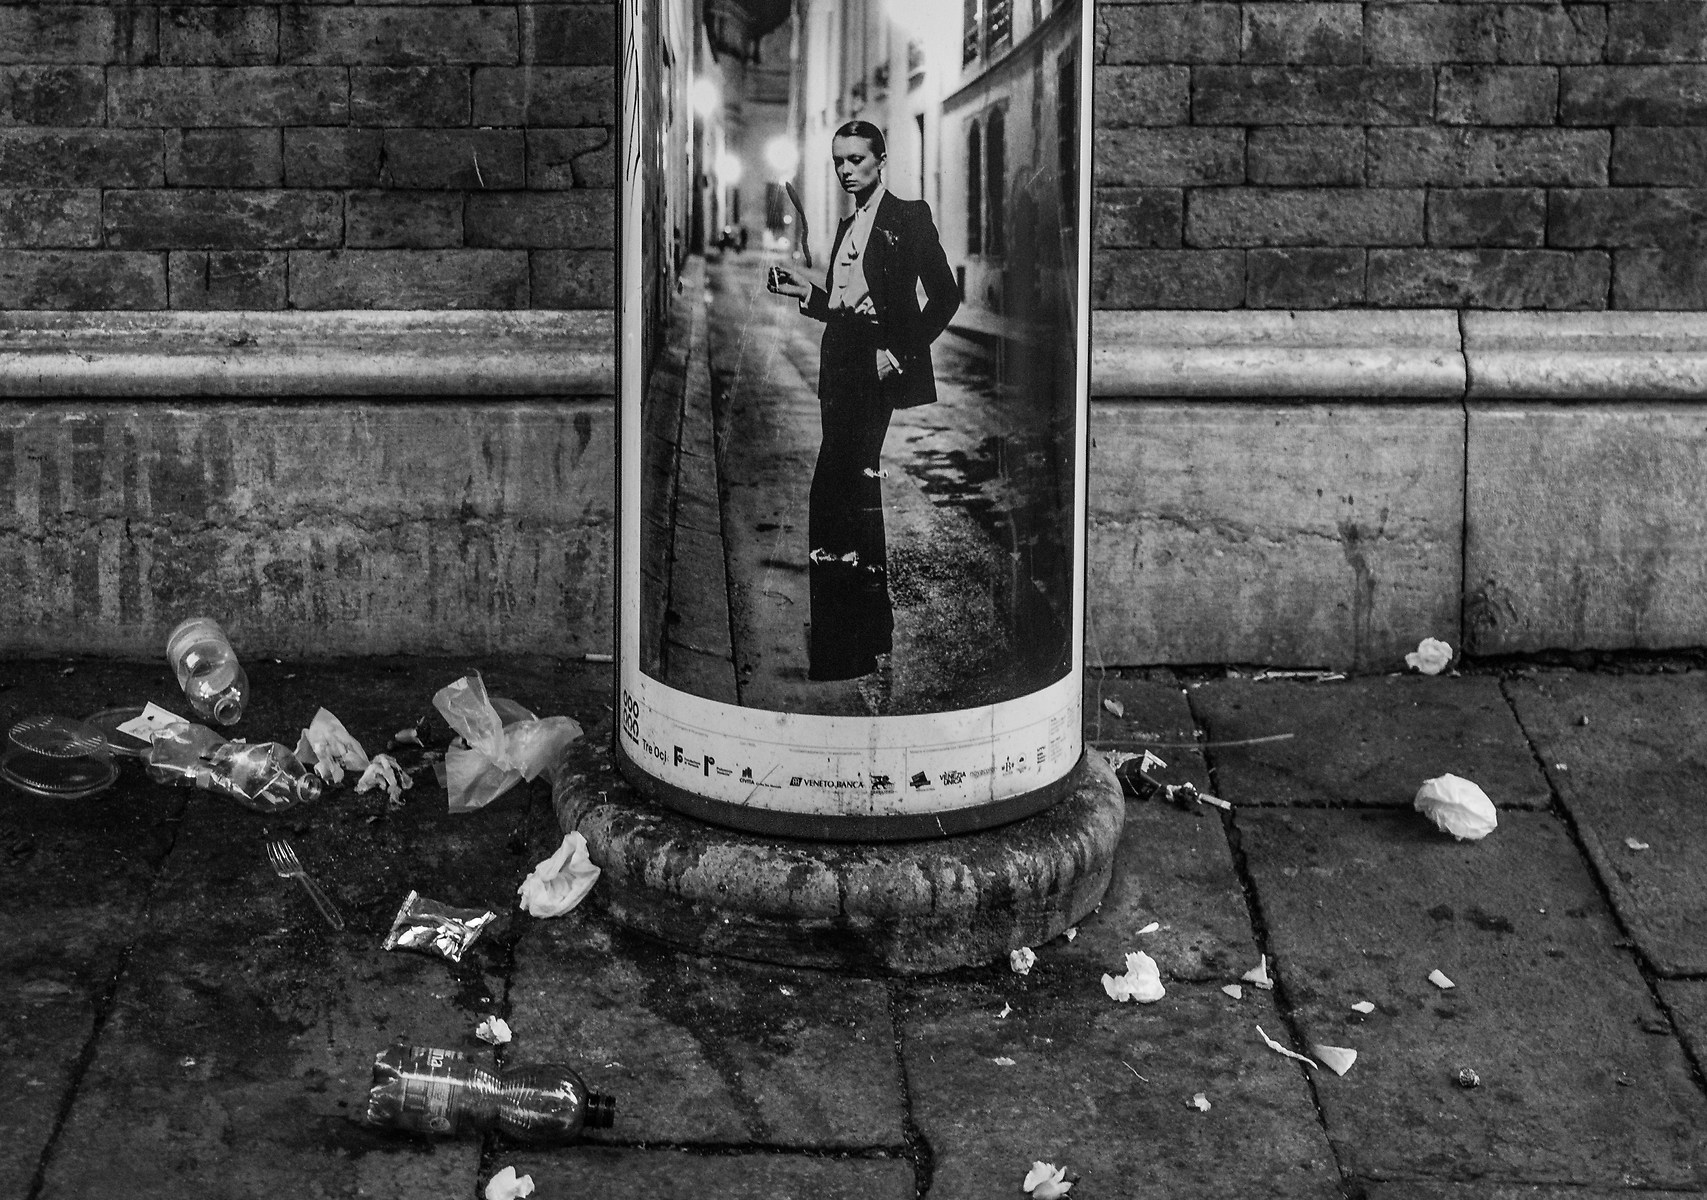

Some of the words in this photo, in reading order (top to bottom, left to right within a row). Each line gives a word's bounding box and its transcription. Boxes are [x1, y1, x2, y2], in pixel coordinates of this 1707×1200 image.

[642, 738, 653, 755] Tre
[803, 778, 836, 789] VENETO
[835, 780, 864, 789] BANCA
